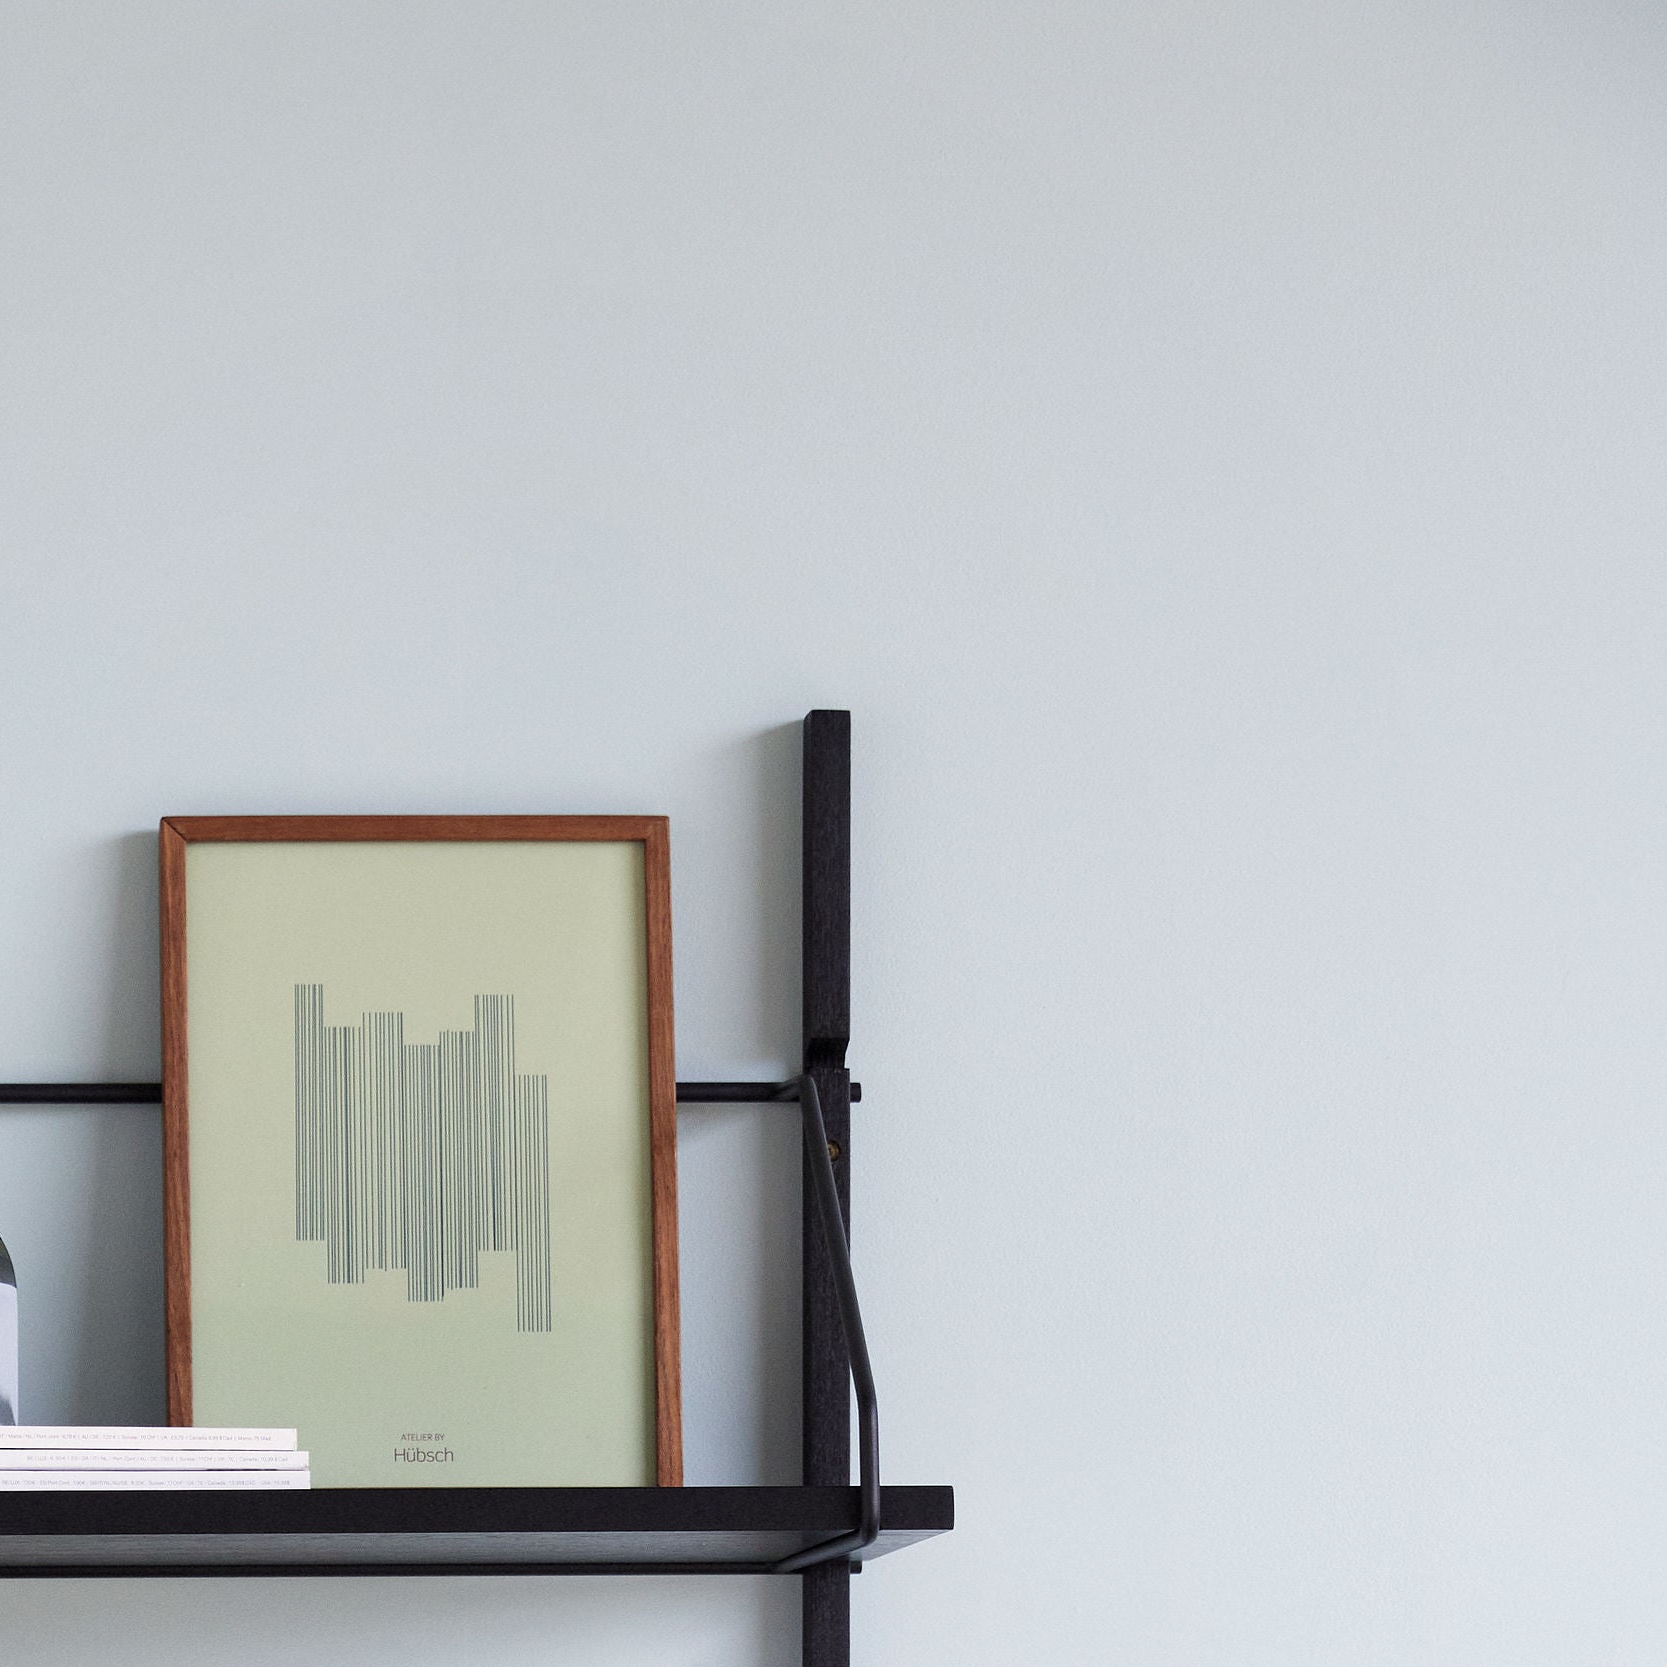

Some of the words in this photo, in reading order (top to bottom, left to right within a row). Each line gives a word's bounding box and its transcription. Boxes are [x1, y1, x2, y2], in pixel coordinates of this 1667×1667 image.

[400, 1433, 433, 1442] ATELIER
[434, 1433, 445, 1442] BY
[394, 1447, 454, 1463] Hübsch
